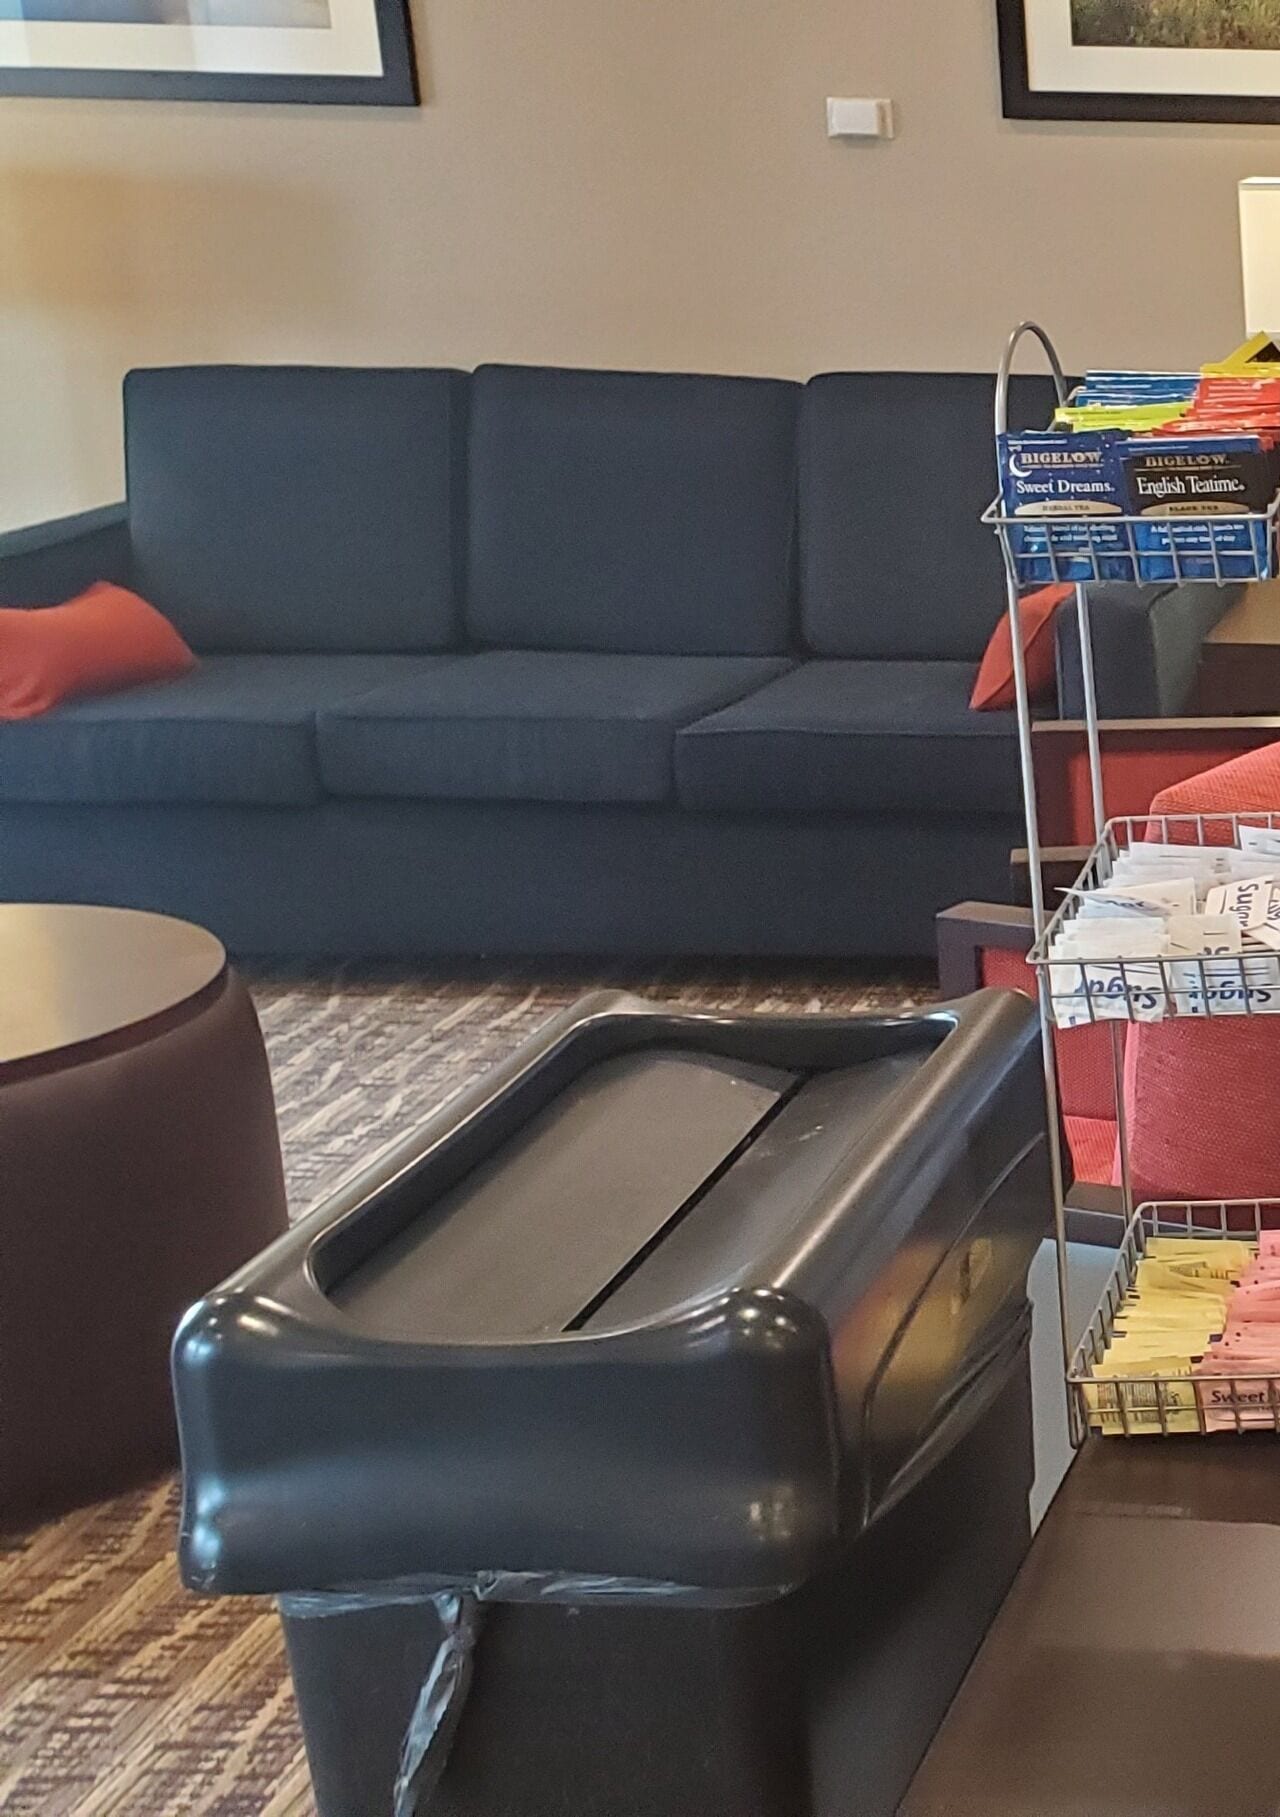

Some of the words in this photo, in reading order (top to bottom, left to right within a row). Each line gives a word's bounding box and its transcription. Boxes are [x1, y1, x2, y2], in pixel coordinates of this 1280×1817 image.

[1020, 451, 1102, 465] BIGELOW
[1016, 478, 1054, 494] Sweet
[1136, 475, 1186, 499] English
